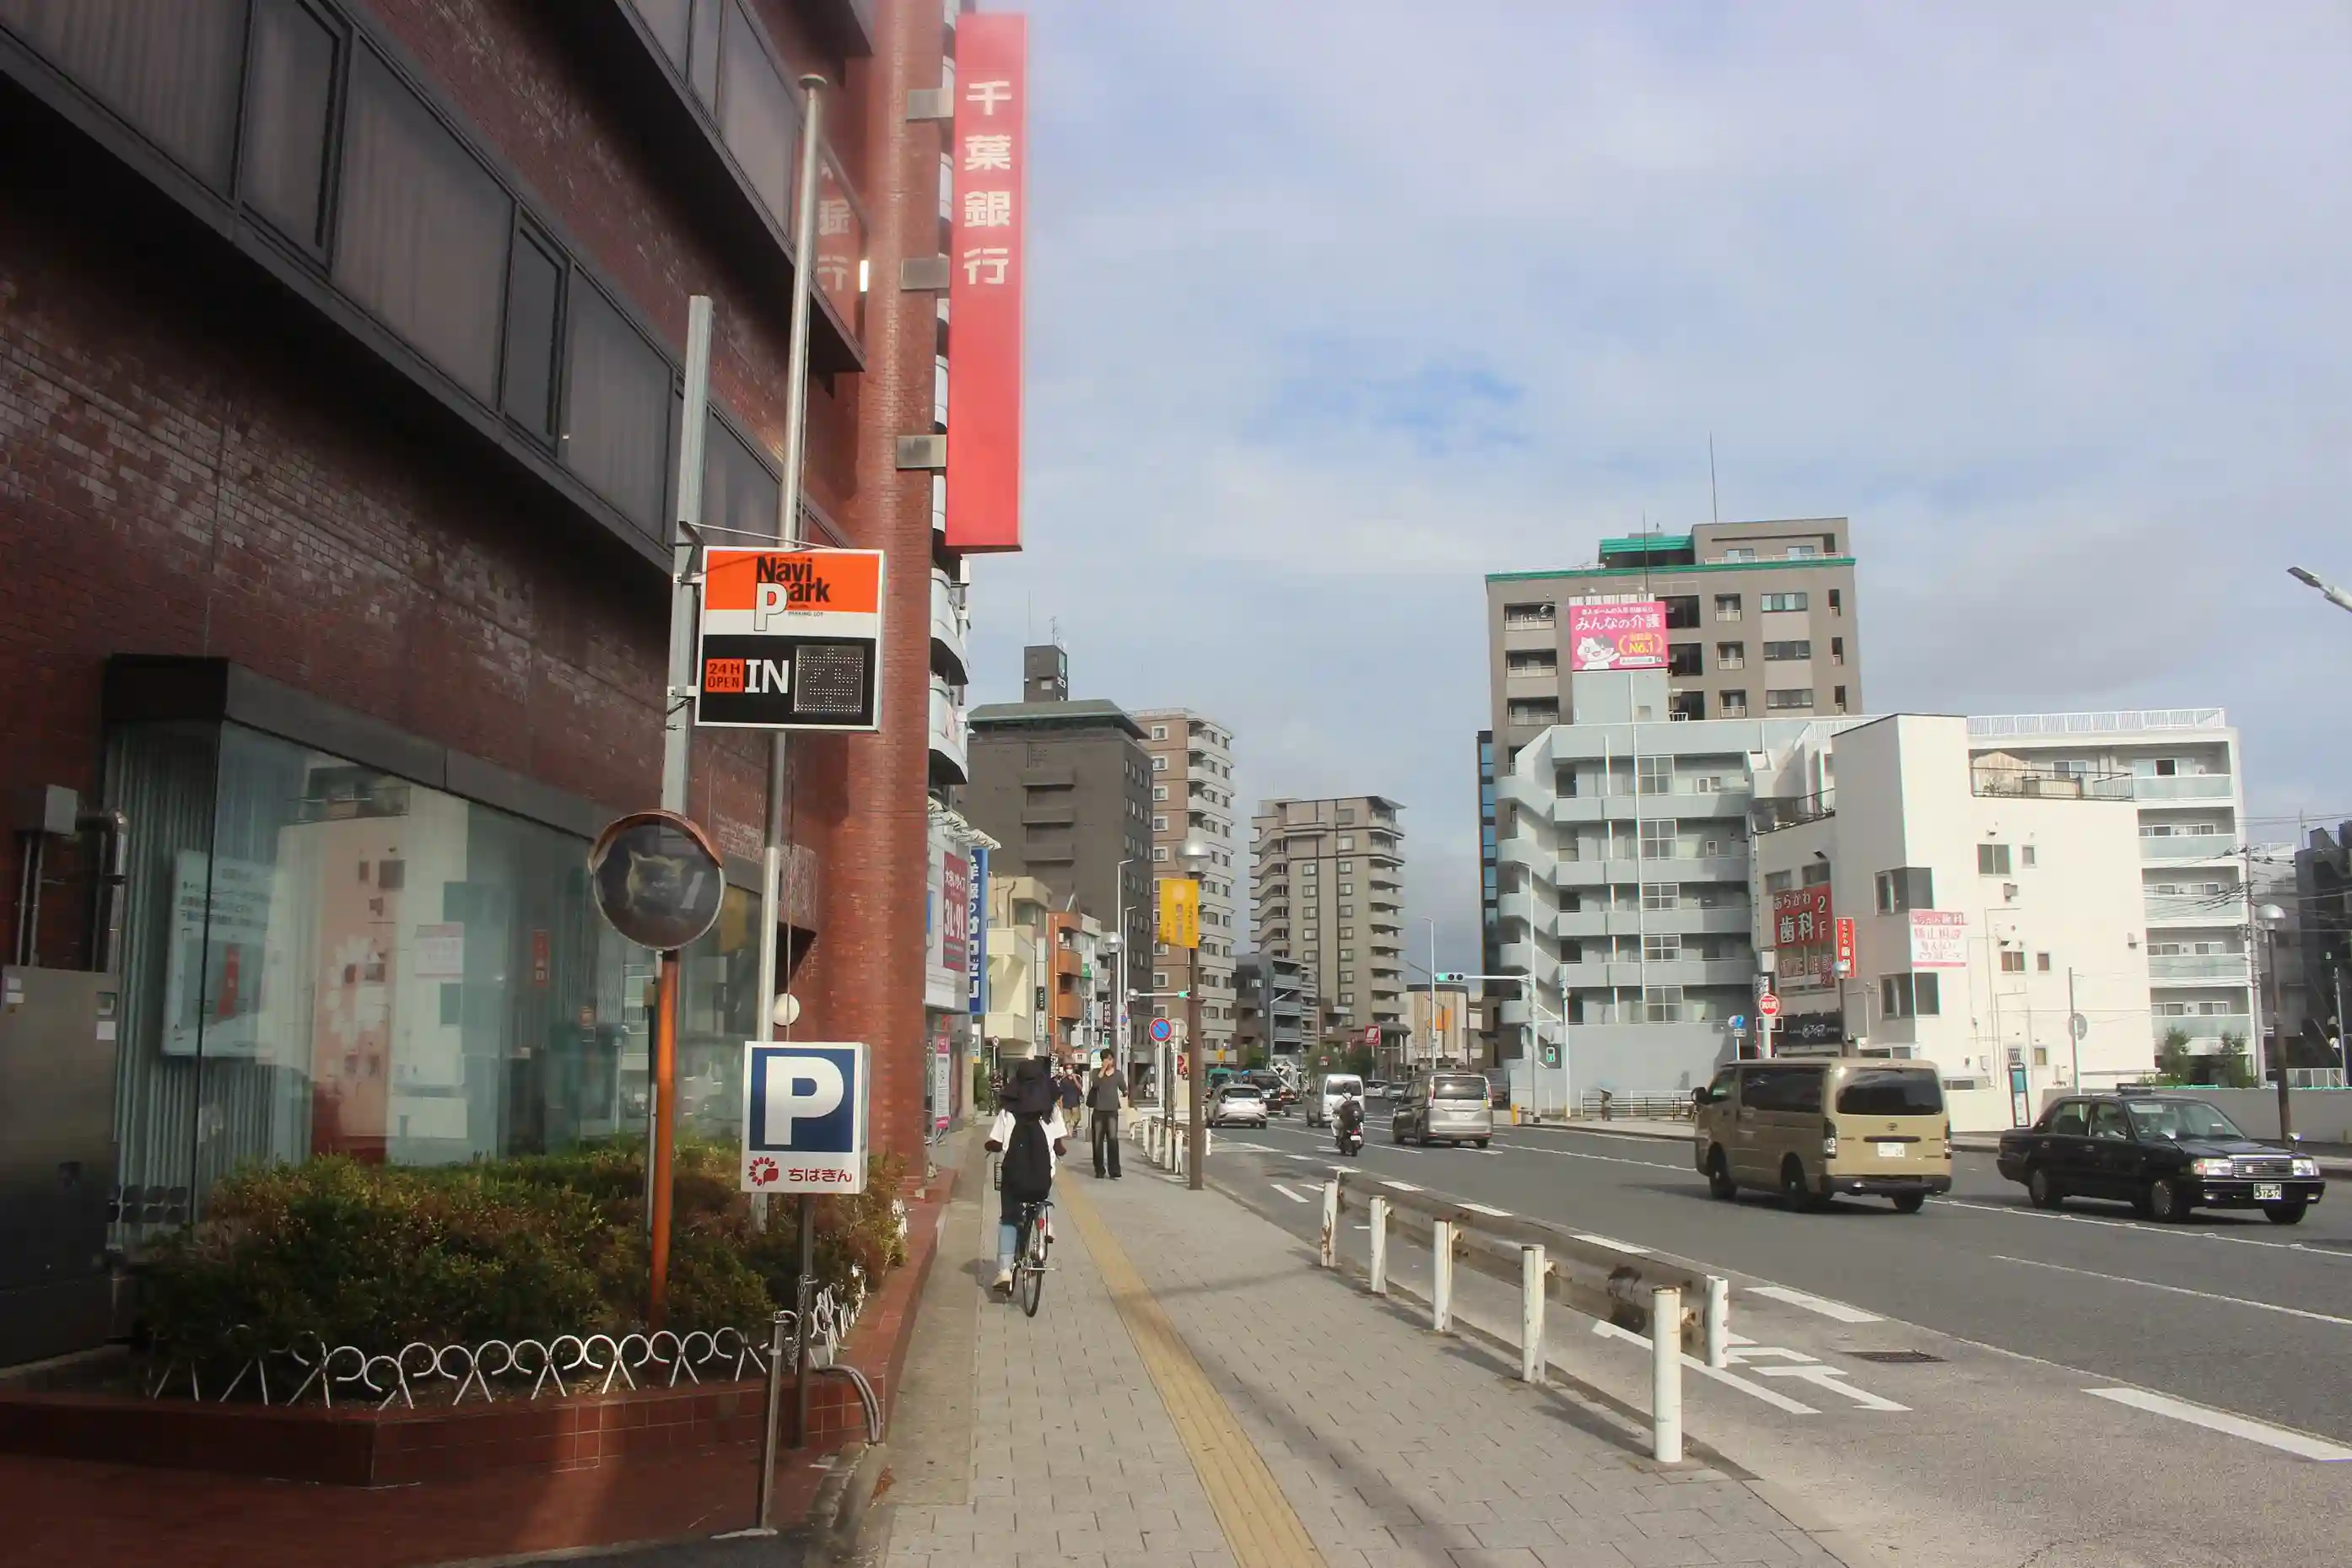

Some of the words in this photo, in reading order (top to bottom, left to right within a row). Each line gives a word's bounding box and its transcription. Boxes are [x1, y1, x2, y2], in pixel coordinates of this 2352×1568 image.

[963, 80, 1012, 285] 千葉銀行
[757, 556, 813, 583] Navi
[754, 577, 831, 632] Park
[1575, 613, 1661, 631] みんなの介護
[708, 676, 740, 689] OPEN
[709, 663, 740, 675] 24H
[744, 659, 790, 694] IN
[1774, 891, 1811, 910] あらかわ
[1780, 911, 1814, 943] 歯科
[764, 1055, 844, 1145] P
[789, 1167, 853, 1183] ちばきん
